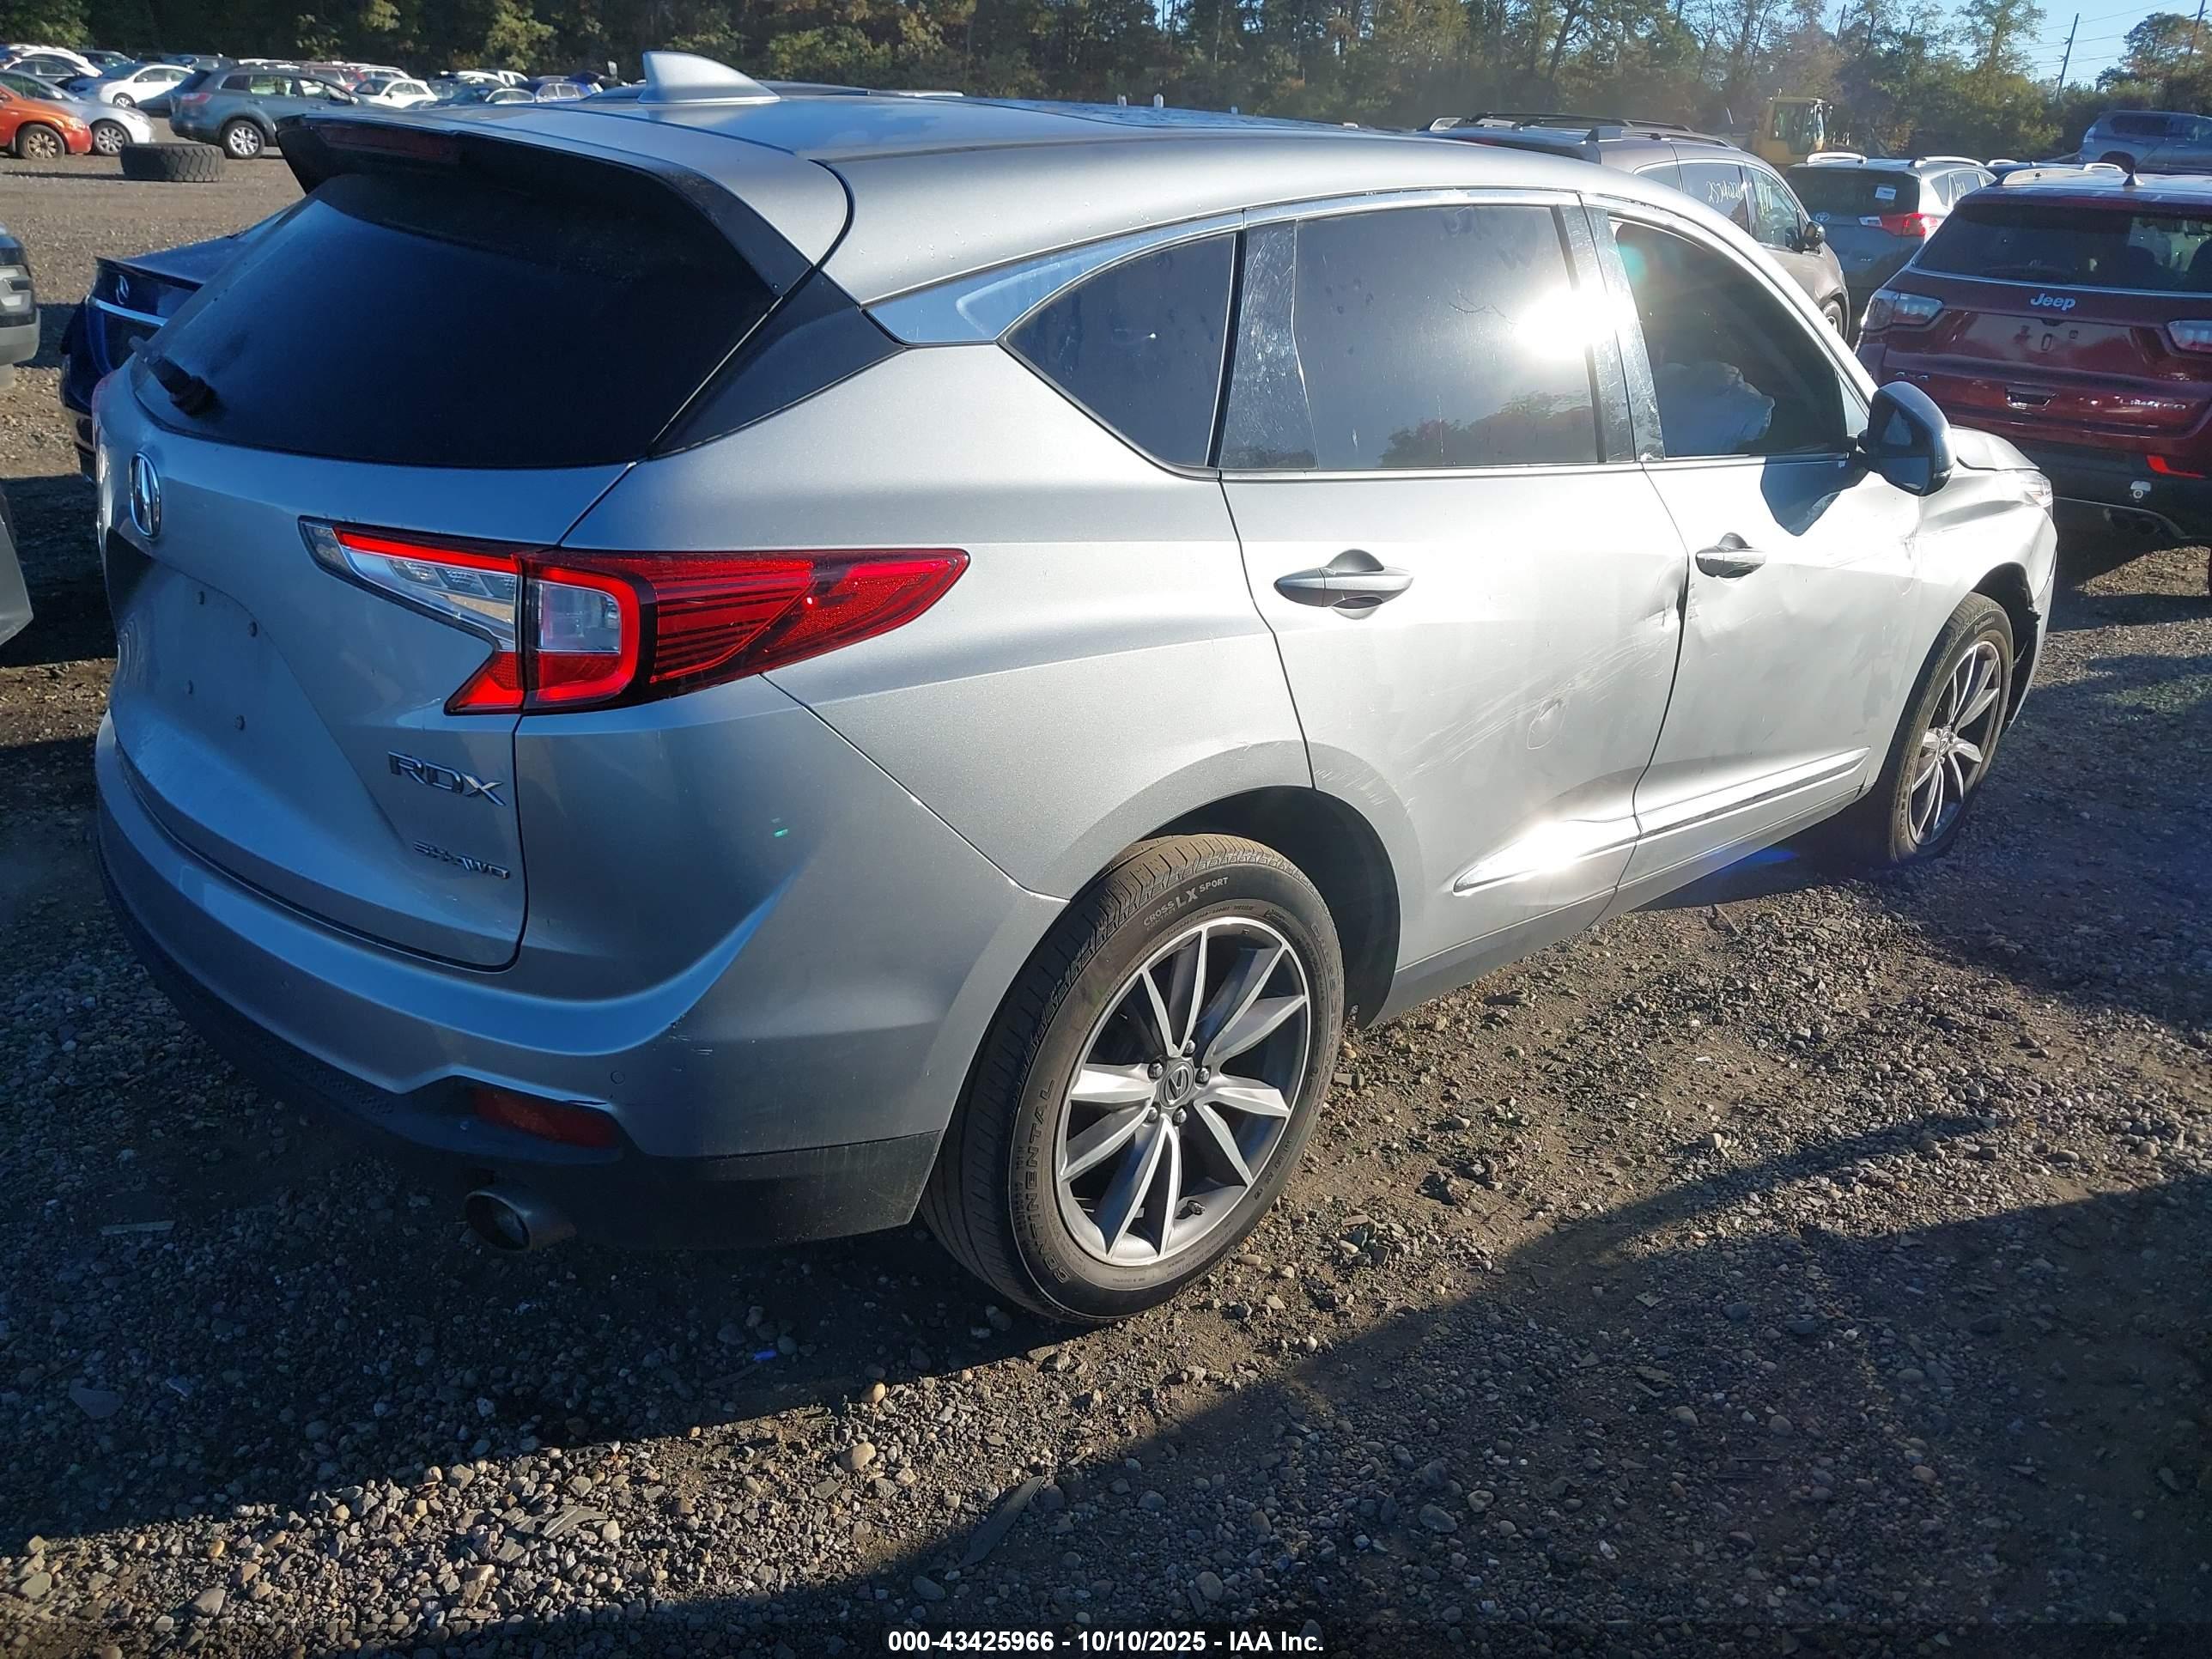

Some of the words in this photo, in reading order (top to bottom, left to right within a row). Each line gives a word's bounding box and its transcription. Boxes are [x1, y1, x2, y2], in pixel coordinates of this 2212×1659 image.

[2030, 293, 2076, 311] Jeep
[387, 750, 506, 805] RDX
[1143, 900, 1175, 927] CROSS
[1175, 887, 1199, 909] LX
[1199, 877, 1230, 893] SPORT
[1027, 1079, 1072, 1284] CONTINENTAL
